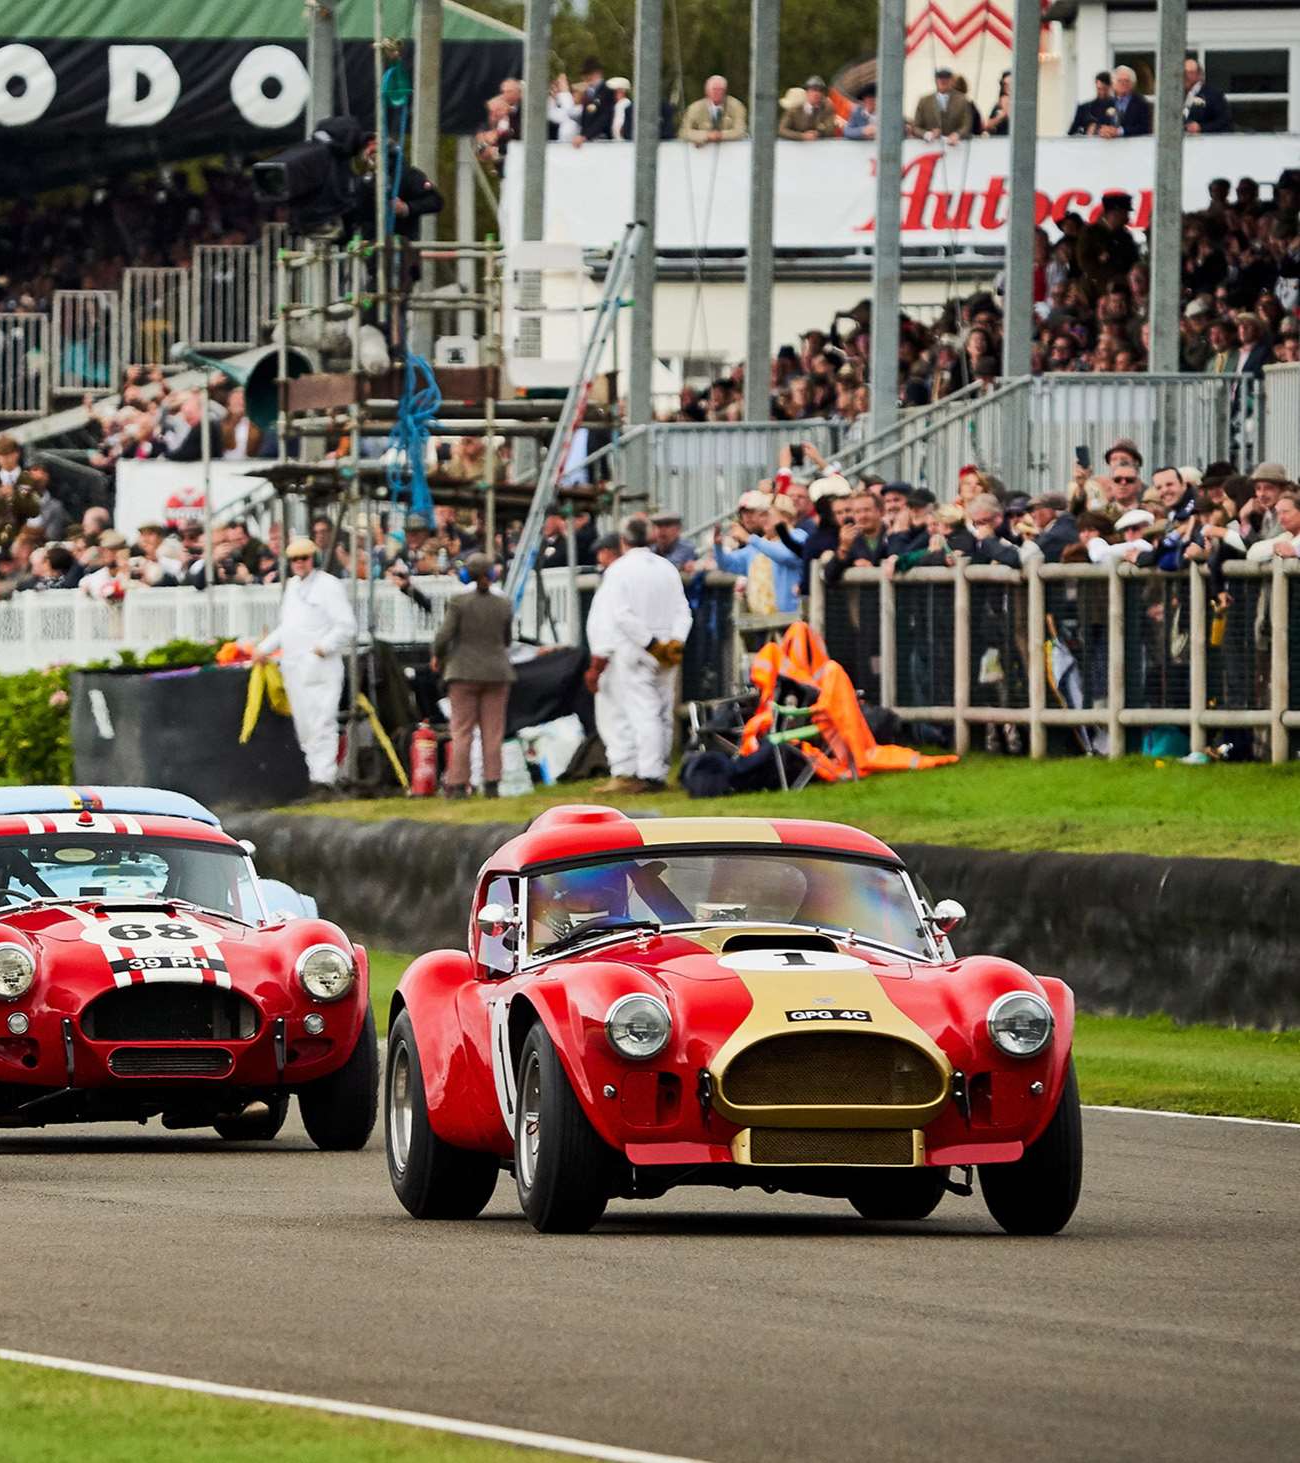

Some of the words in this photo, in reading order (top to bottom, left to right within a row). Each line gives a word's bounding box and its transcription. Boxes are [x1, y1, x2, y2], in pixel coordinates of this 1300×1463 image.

[108, 923, 199, 941] 68
[128, 957, 162, 970] 39
[169, 957, 210, 969] PH
[773, 952, 817, 966] 1
[790, 1010, 833, 1020] GPG
[840, 1011, 867, 1020] 4C
